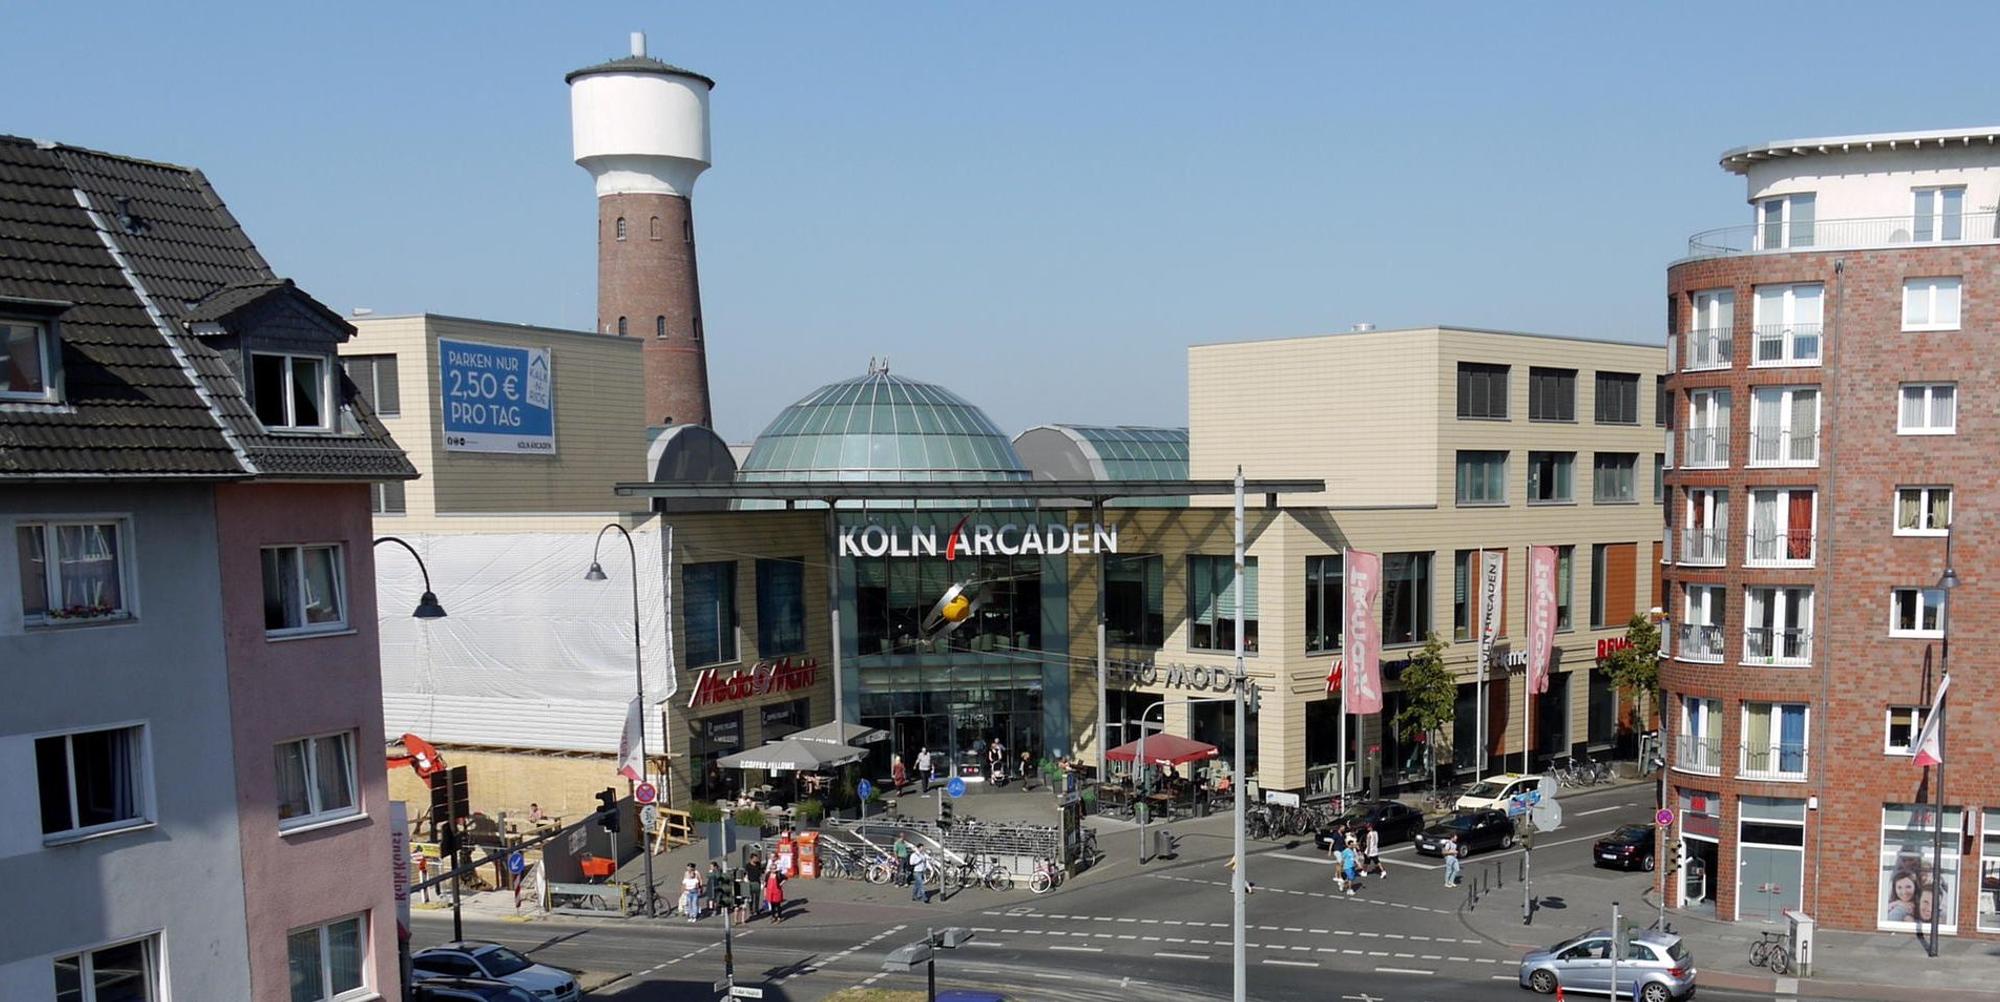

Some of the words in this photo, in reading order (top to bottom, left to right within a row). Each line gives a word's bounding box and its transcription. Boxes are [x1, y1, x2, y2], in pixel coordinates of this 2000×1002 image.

[448, 351, 492, 368] PARKEN
[496, 357, 519, 372] NUR
[449, 369, 498, 400] 2,50
[502, 374, 520, 401] €
[451, 402, 487, 425] PRO
[489, 405, 521, 427] TAG
[838, 517, 937, 557] KÖLN
[946, 510, 1119, 560] ARCADEN
[687, 668, 755, 708] Media
[769, 655, 818, 694] Markt
